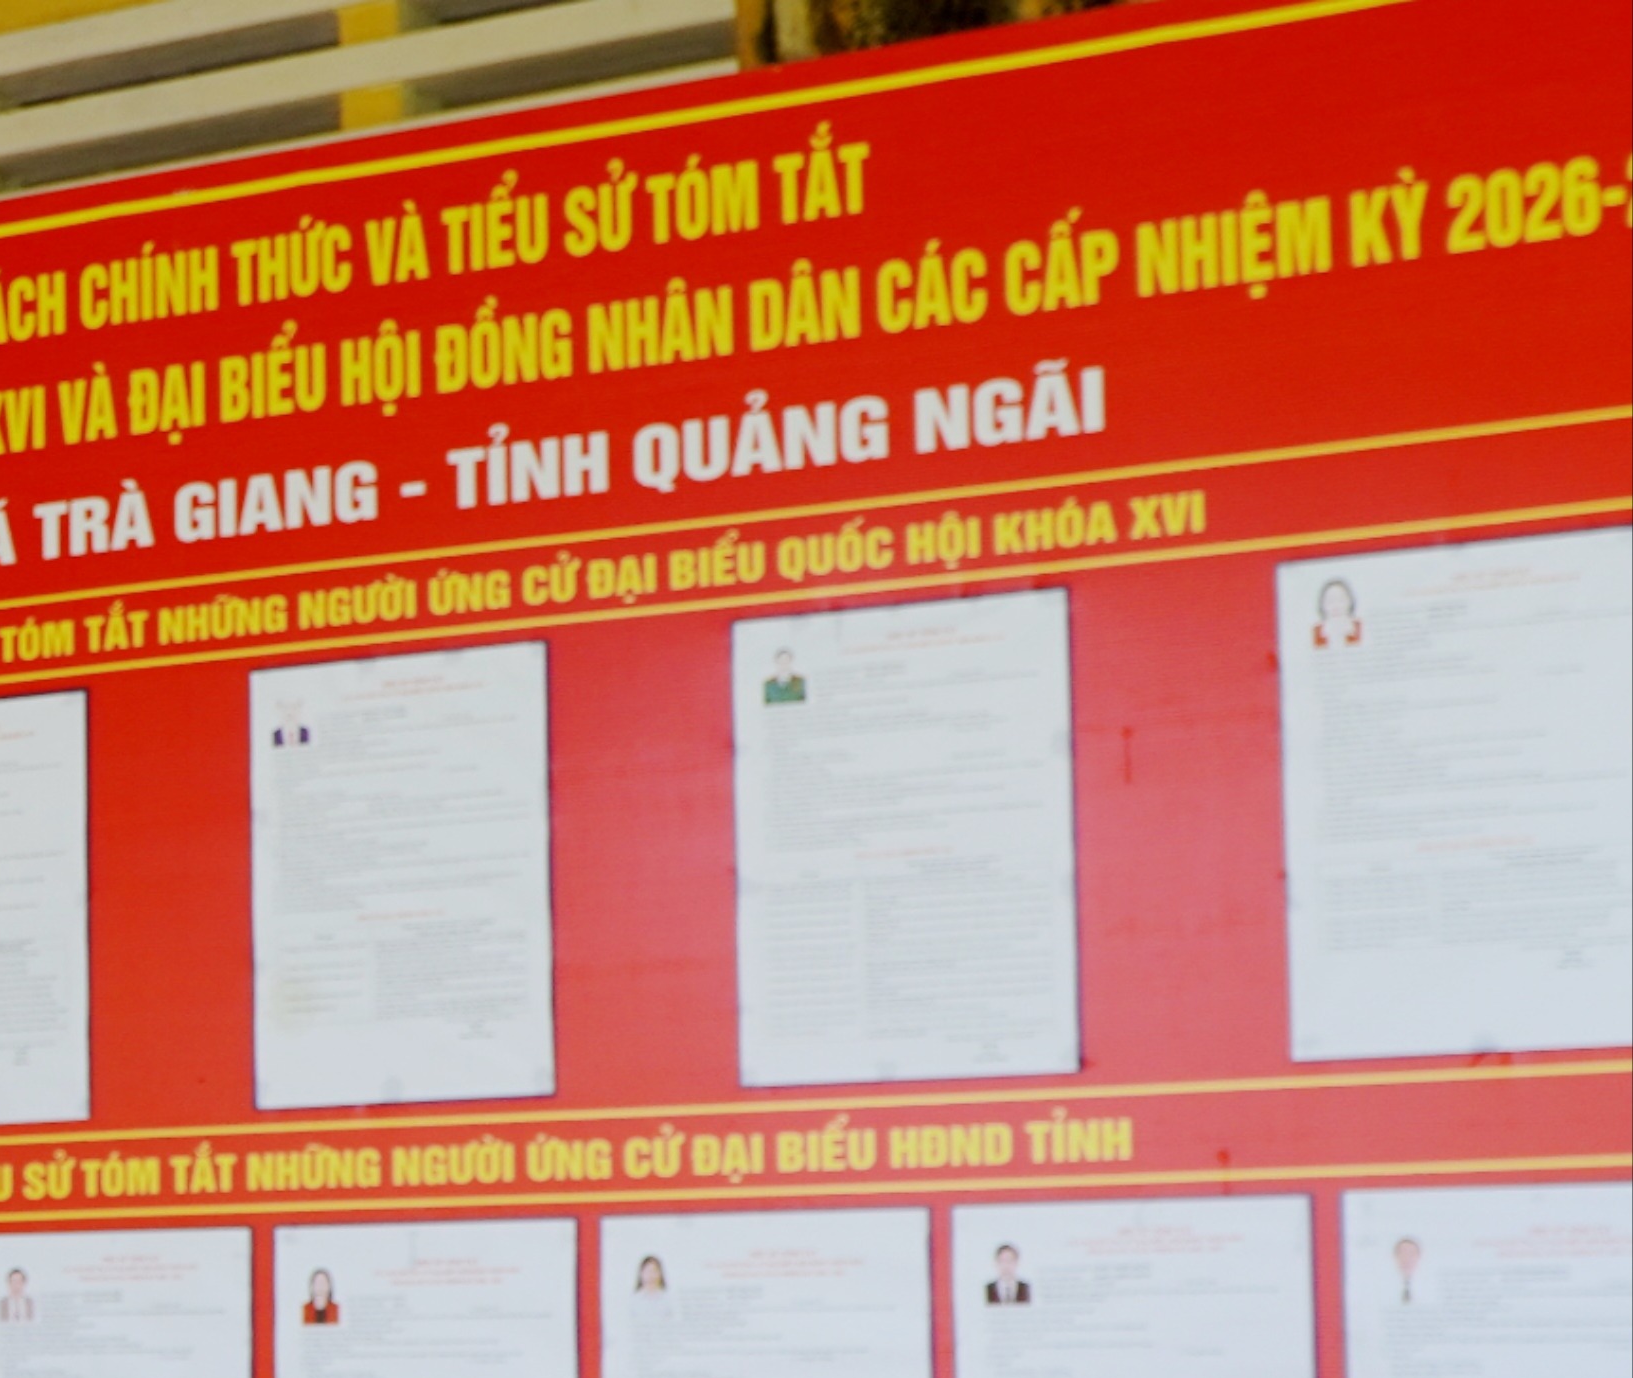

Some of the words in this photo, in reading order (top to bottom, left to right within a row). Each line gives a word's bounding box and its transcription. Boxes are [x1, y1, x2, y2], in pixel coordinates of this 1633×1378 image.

[57, 361, 118, 445] VÀ
[127, 361, 206, 446] ĐẠI
[219, 320, 326, 423] BIỂU
[340, 318, 421, 417] HỘI
[434, 295, 573, 394] ĐỒNG
[587, 277, 734, 374] NHÂN
[748, 258, 861, 352] DÂN
[876, 238, 988, 334] CÁC
[1004, 206, 1119, 316] CẤP
[1136, 189, 1332, 300] NHIỆM
[1349, 166, 1428, 268] KỲ
[1446, 152, 1633, 254] 2026-
[79, 241, 219, 330] CHÍNH
[230, 215, 352, 306] THỨC
[365, 199, 430, 286] VÀ
[440, 169, 549, 275] TIỂU
[564, 158, 638, 258] SỬ
[645, 154, 759, 245] TÓM
[773, 121, 870, 225] TẮT
[32, 478, 155, 561] TRÀ
[174, 460, 378, 543] GIANG
[446, 422, 610, 510] TỈNH
[633, 388, 890, 493] QUẢNG
[913, 358, 1106, 455] NGÃI
[84, 600, 149, 653] TẮT
[158, 594, 288, 645] NHỮNG
[298, 574, 417, 630] NGƯỜI
[428, 569, 511, 616] ỨNG
[522, 551, 581, 606] CỬ
[586, 553, 657, 604] ĐẠI
[669, 530, 765, 591] BIỂU
[777, 518, 894, 582] QUỐC
[906, 511, 981, 570] HỘI
[993, 498, 1117, 555] KHÓA
[1129, 490, 1206, 540] XVI
[23, 1151, 76, 1200] SỬ
[81, 1152, 160, 1197] TÓM
[170, 1142, 237, 1194] TẮT
[247, 1144, 381, 1191] NHỮNG
[392, 1135, 515, 1186] NGƯỜI
[526, 1134, 612, 1181] ỨNG
[624, 1125, 685, 1178] CỬ
[692, 1133, 764, 1183] ĐẠI
[777, 1115, 876, 1173] BIỂU
[889, 1123, 1013, 1168] HĐND
[1026, 1108, 1132, 1163] TỈNH
